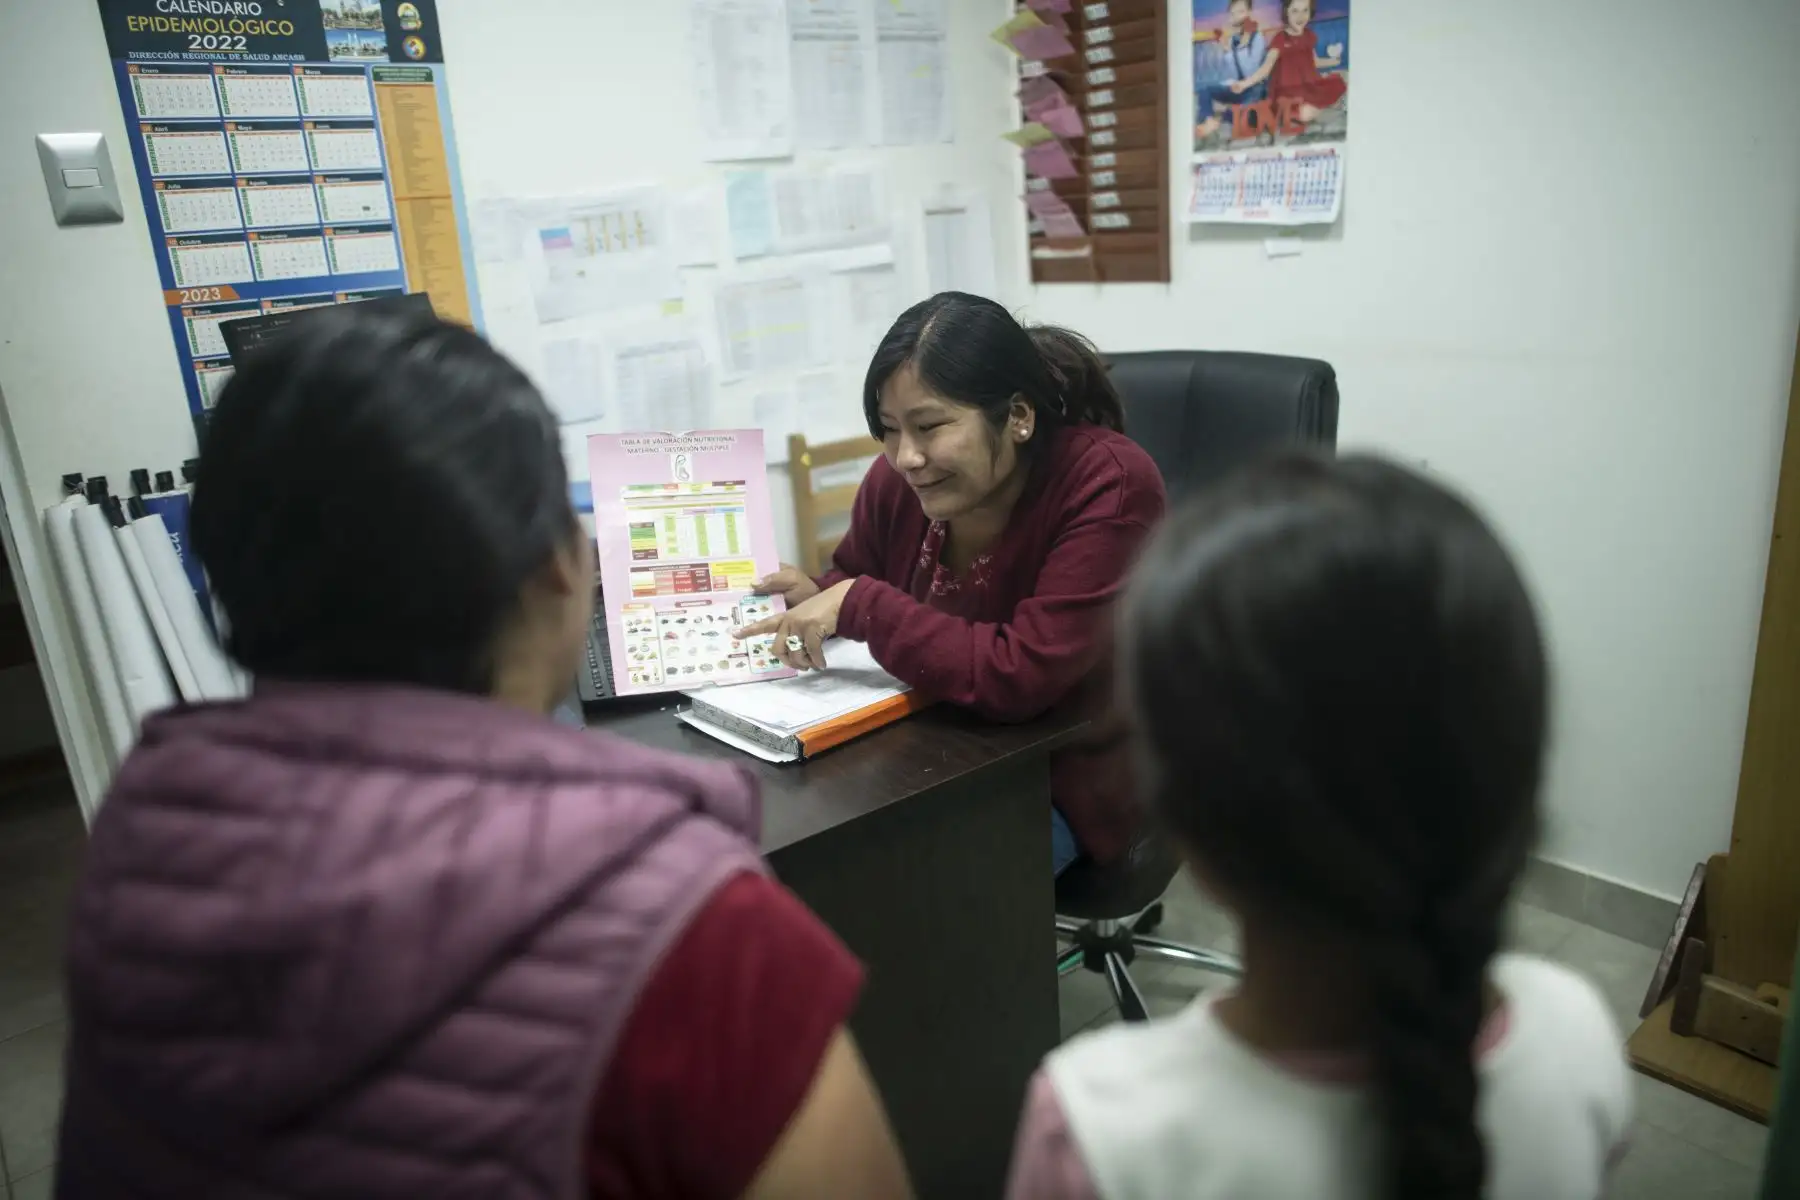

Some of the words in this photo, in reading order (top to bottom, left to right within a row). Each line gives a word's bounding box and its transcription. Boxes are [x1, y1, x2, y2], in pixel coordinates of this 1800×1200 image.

[156, 0, 262, 16] CALENDARIO
[127, 15, 294, 36] EPIDEMIOLÓGICO
[188, 34, 247, 50] 2022
[129, 50, 180, 60] DIRECCIÓN
[182, 52, 227, 61] REGIONAL
[229, 53, 241, 61] DE
[243, 53, 270, 61] SALUD
[272, 54, 306, 62] ANCASH
[1231, 96, 1305, 139] LOVE
[180, 287, 221, 303] 2023
[652, 436, 693, 444] VALORACIÓN
[694, 435, 735, 443] NUTRICIONAL
